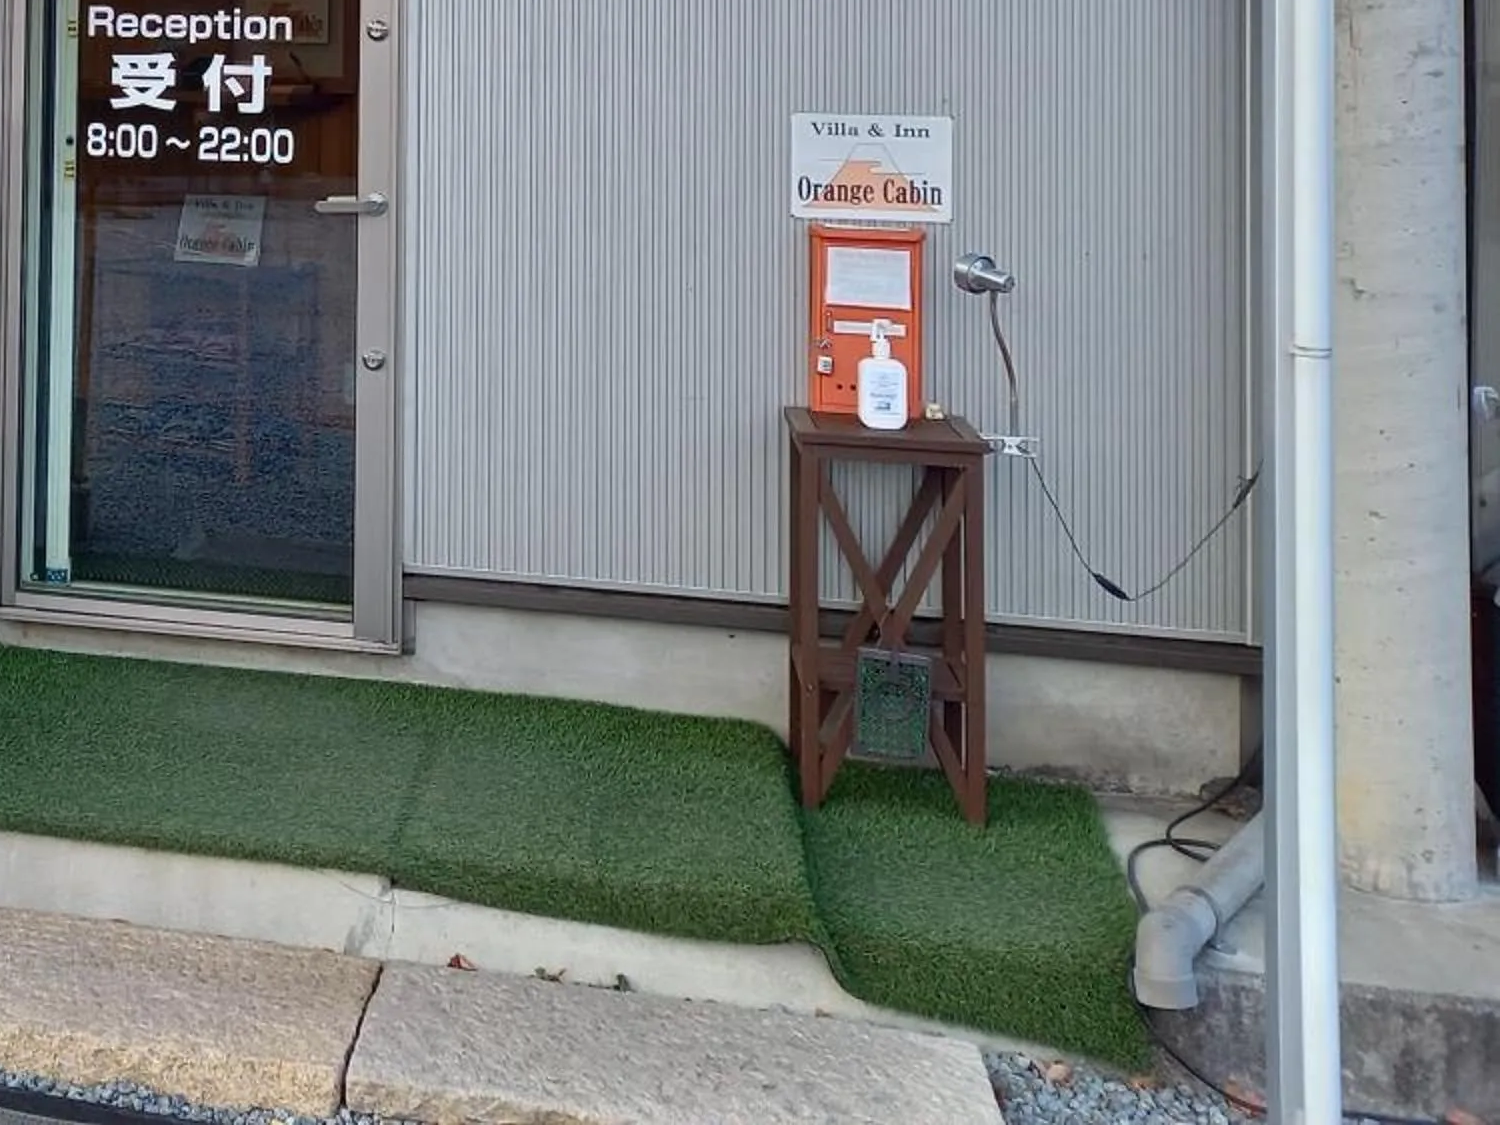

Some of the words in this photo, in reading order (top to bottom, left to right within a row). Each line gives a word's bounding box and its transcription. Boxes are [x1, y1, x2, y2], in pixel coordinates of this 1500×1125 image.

[87, 6, 293, 43] Reception
[109, 52, 273, 114] 受付
[811, 122, 859, 137] Villa
[867, 123, 885, 137] &
[894, 124, 930, 138] Inn
[798, 175, 875, 206] Orange
[883, 179, 943, 206] Cabin
